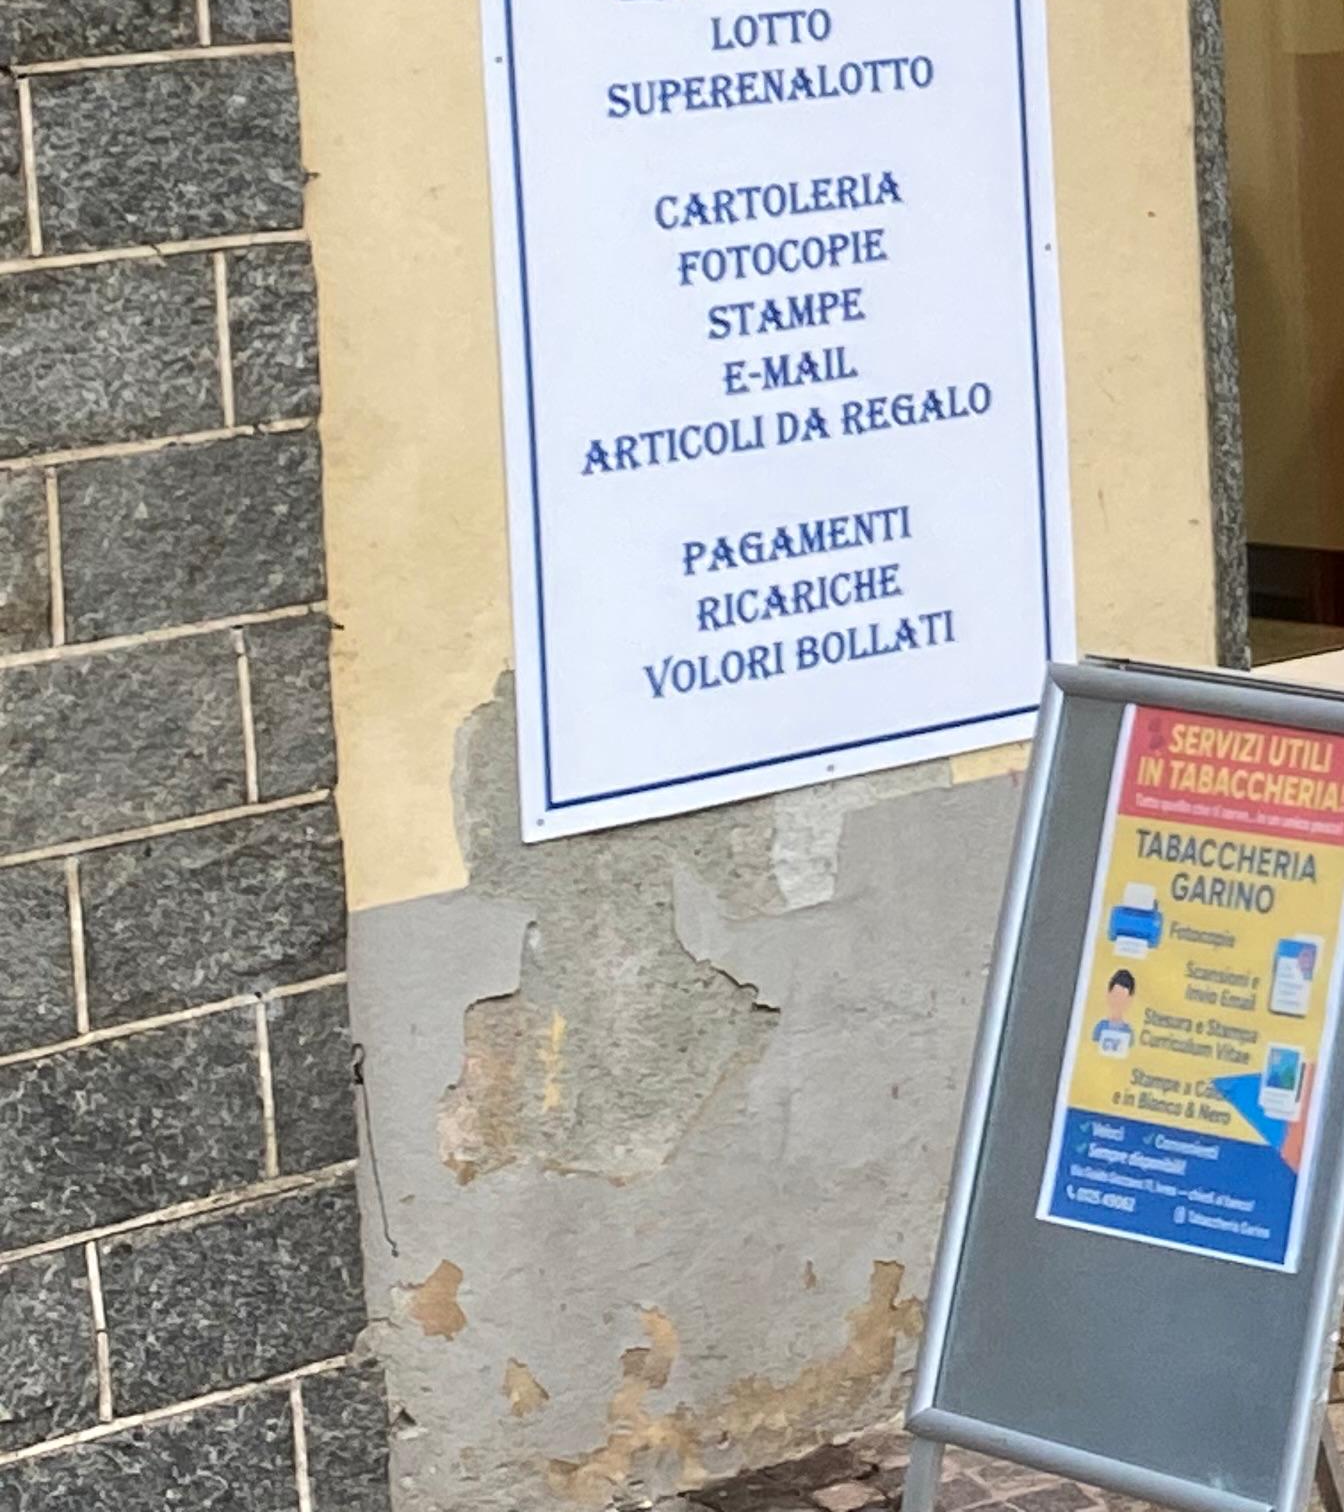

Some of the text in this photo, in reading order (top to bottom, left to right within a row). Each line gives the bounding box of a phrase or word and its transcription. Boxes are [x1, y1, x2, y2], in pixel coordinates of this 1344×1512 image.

[711, 9, 831, 51] LOTTO
[607, 56, 934, 119] SUPERENALOTTO
[654, 170, 904, 231] CARTOLERIA
[677, 228, 887, 287] FOTOCOPIE
[708, 288, 865, 341] STAMPE
[724, 346, 858, 395] E-MAIL
[582, 381, 993, 476] ARTICOLI DA REGALO
[682, 505, 913, 576] PAGAMENTI
[697, 563, 903, 632] RICARICHE
[644, 609, 956, 699] VOLORI BOLLATI
[1137, 755, 1163, 787] IN
[1168, 724, 1334, 774] SERVIZI UTILI
[1135, 829, 1317, 883] TABACCHERIA
[1171, 873, 1275, 915] GARINO
